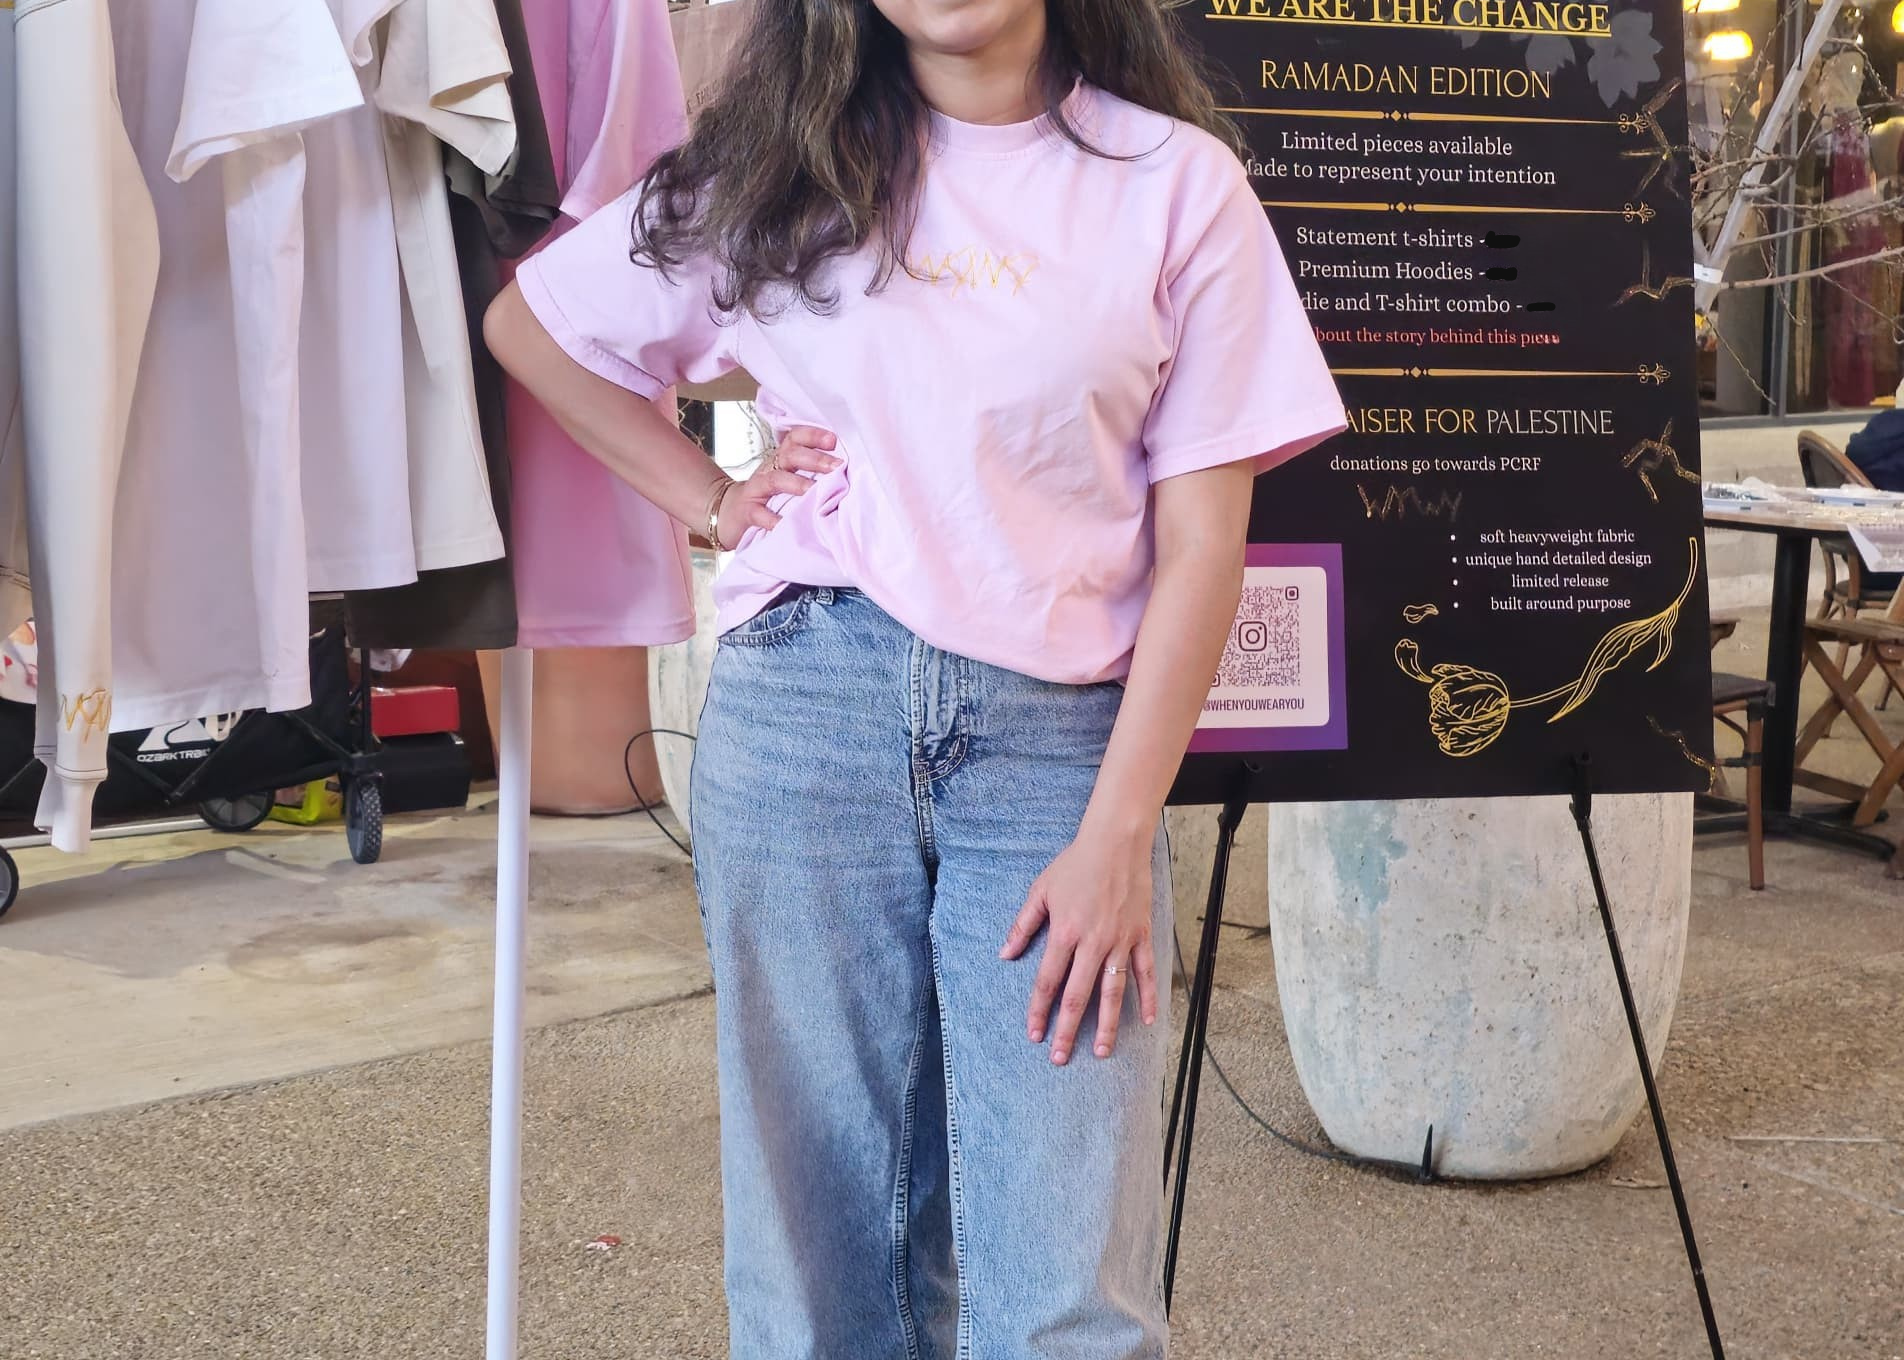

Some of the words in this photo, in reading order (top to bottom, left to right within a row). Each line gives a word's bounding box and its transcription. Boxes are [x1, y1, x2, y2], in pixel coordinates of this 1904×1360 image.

[1261, 59, 1418, 94] RAMADAN
[1430, 67, 1551, 98] EDITION
[1281, 131, 1358, 151] Limited
[1363, 133, 1424, 156] pieces
[1428, 137, 1513, 157] available
[1293, 162, 1313, 178] to
[1318, 164, 1412, 183] represent
[1416, 167, 1463, 185] your
[1468, 165, 1556, 185] intention
[1297, 227, 1397, 246] Statement
[1403, 229, 1473, 247] t-shirts
[1299, 261, 1390, 279] Premium
[1395, 262, 1473, 280] Hoodies
[1301, 292, 1329, 310] die
[1334, 293, 1370, 311] and
[1376, 294, 1441, 312] T-shirt
[1447, 295, 1510, 313] combo
[1315, 327, 1351, 342] bout
[1356, 327, 1381, 342] the
[1385, 330, 1426, 346] story
[1430, 328, 1484, 344] behind
[1488, 328, 1516, 344] this
[1346, 408, 1416, 433] AISER
[1426, 408, 1477, 433] FOR
[1487, 409, 1614, 434] PALESTINE
[1330, 455, 1408, 471] donations
[1412, 459, 1430, 475] go
[1434, 456, 1496, 471] towards
[1500, 457, 1541, 471] PCRF
[1480, 530, 1505, 543] soft
[1509, 529, 1593, 546] heavyweight
[1597, 529, 1635, 543] fabric
[1465, 553, 1513, 568] unique
[1516, 552, 1549, 565] hand
[1552, 551, 1606, 565] detailed
[1609, 551, 1652, 568] design
[1512, 574, 1559, 588] limited
[1563, 573, 1609, 587] release
[1491, 597, 1522, 611] built
[1526, 596, 1574, 610] around
[1577, 598, 1631, 613] purpose
